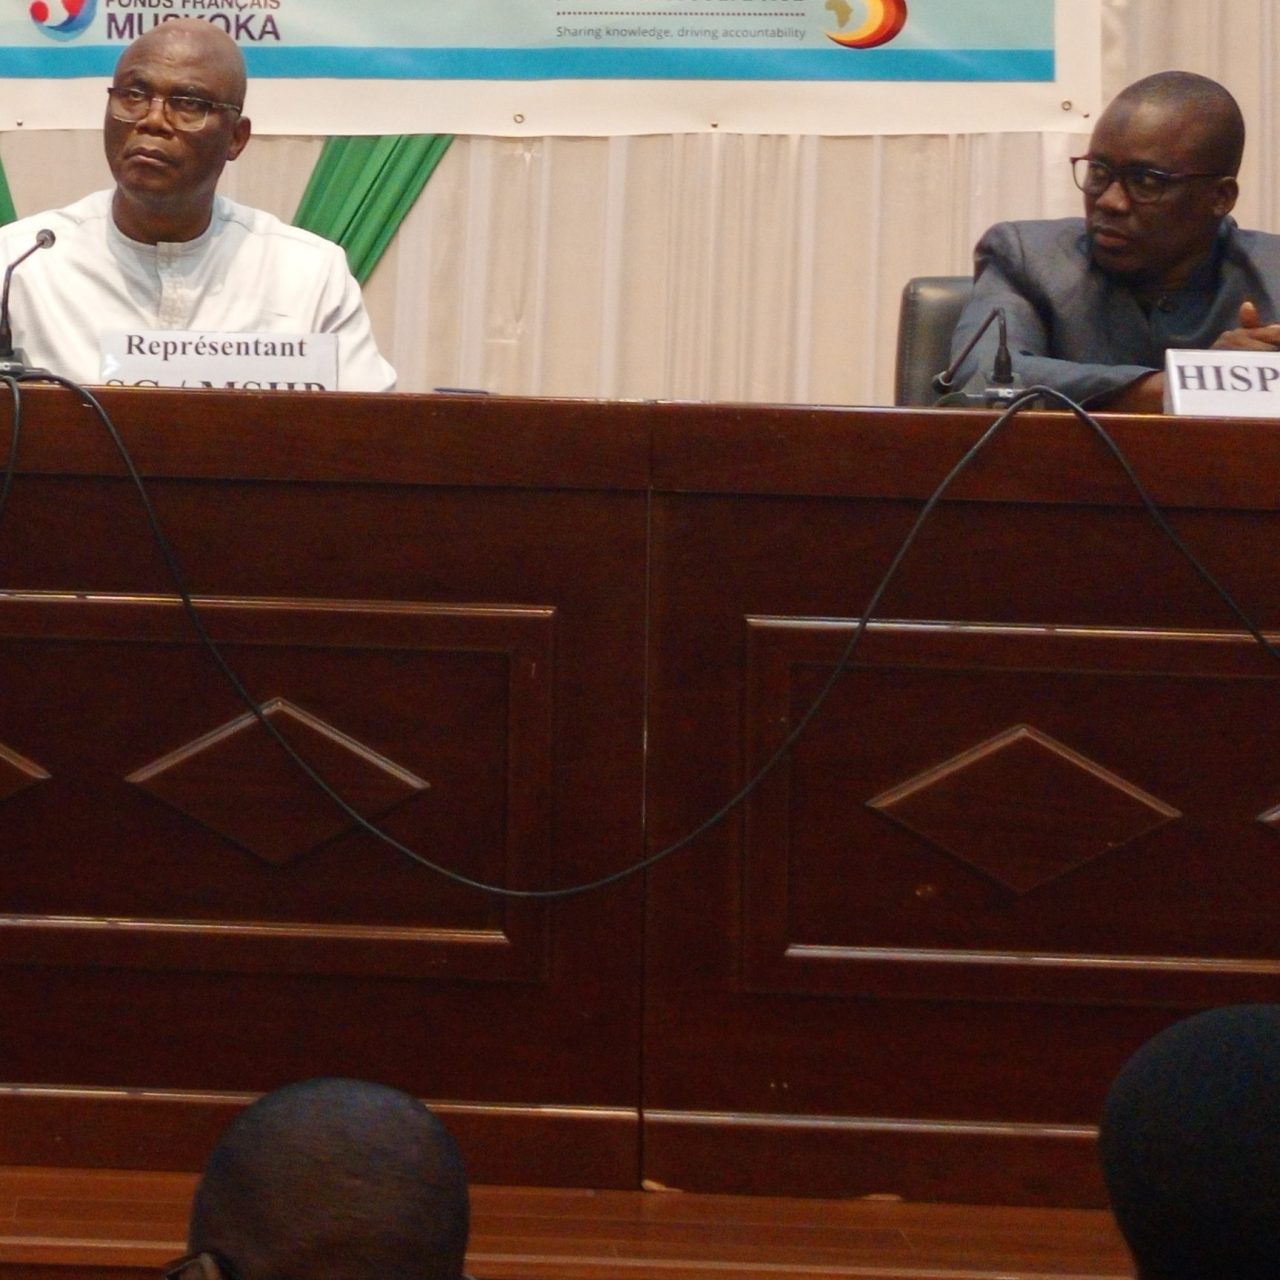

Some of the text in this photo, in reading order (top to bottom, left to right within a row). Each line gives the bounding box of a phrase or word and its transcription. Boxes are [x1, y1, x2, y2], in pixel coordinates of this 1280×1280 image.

[556, 26, 601, 39] Sharing
[677, 27, 718, 40] driving
[722, 27, 806, 40] accountability
[126, 334, 307, 361] Représentant
[1177, 365, 1280, 392] HISP
